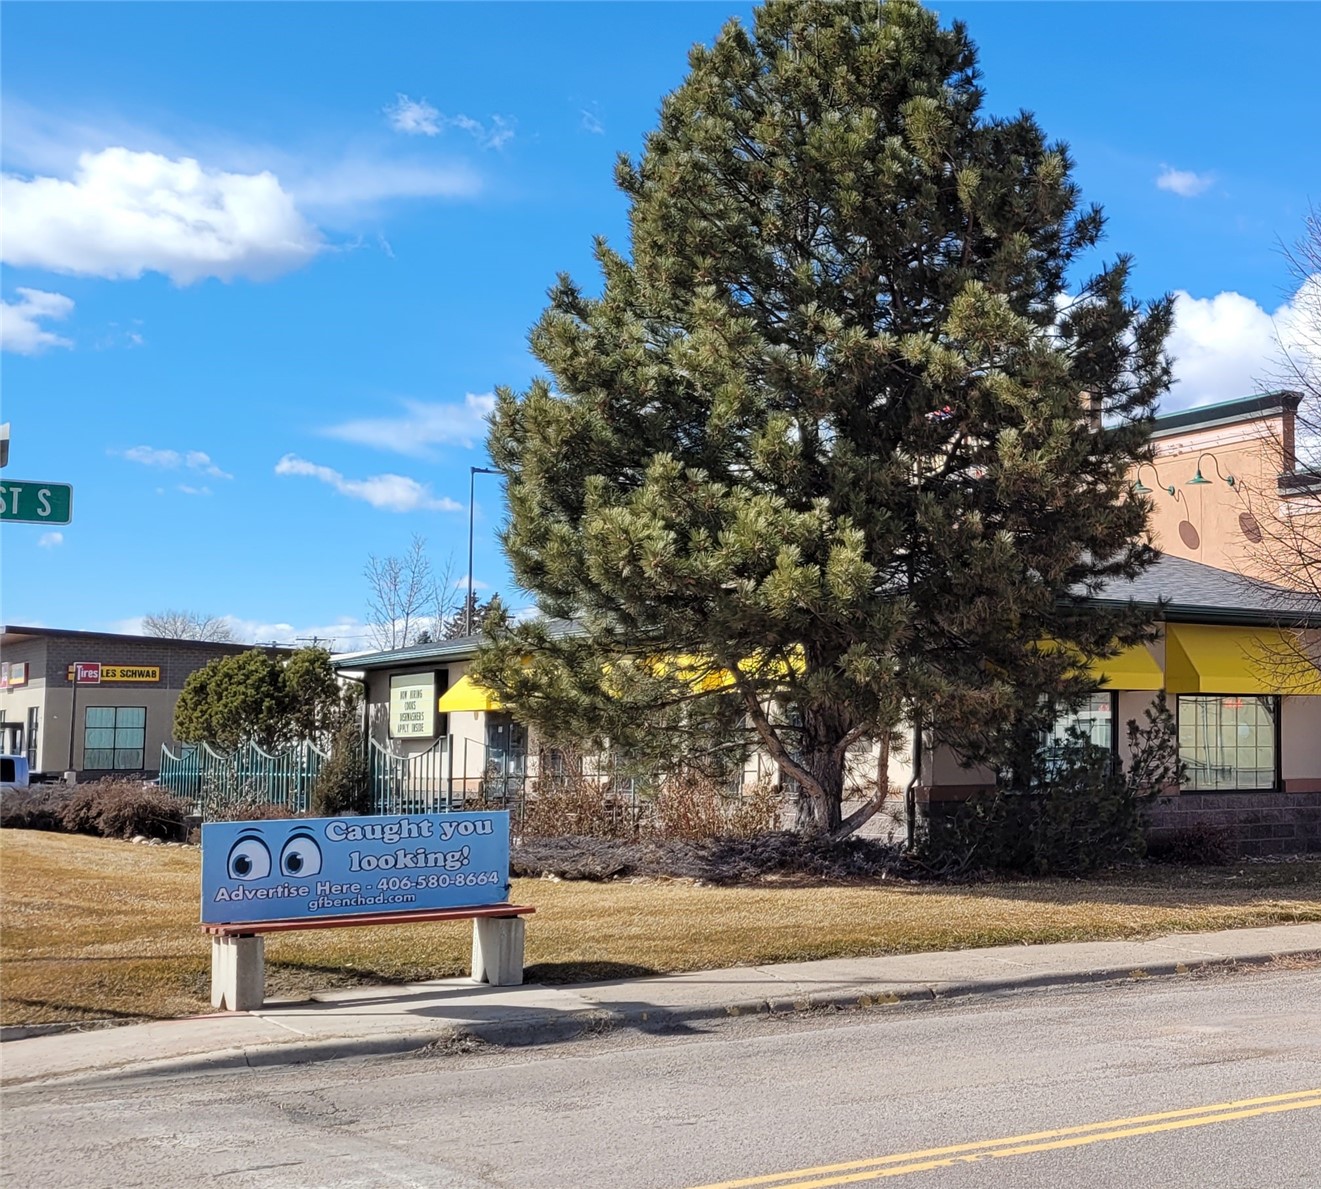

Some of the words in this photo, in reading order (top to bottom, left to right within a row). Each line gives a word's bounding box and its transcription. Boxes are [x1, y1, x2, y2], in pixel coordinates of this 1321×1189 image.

[37, 488, 51, 517] S
[77, 665, 98, 680] Tires
[101, 669, 117, 678] LES
[120, 669, 157, 678] SCHWAB
[325, 818, 433, 844] Caught
[440, 819, 493, 841] you
[349, 845, 471, 872] looking!
[214, 884, 309, 902] Advertise
[316, 881, 361, 896] Here
[377, 871, 499, 892] 406-580-8664
